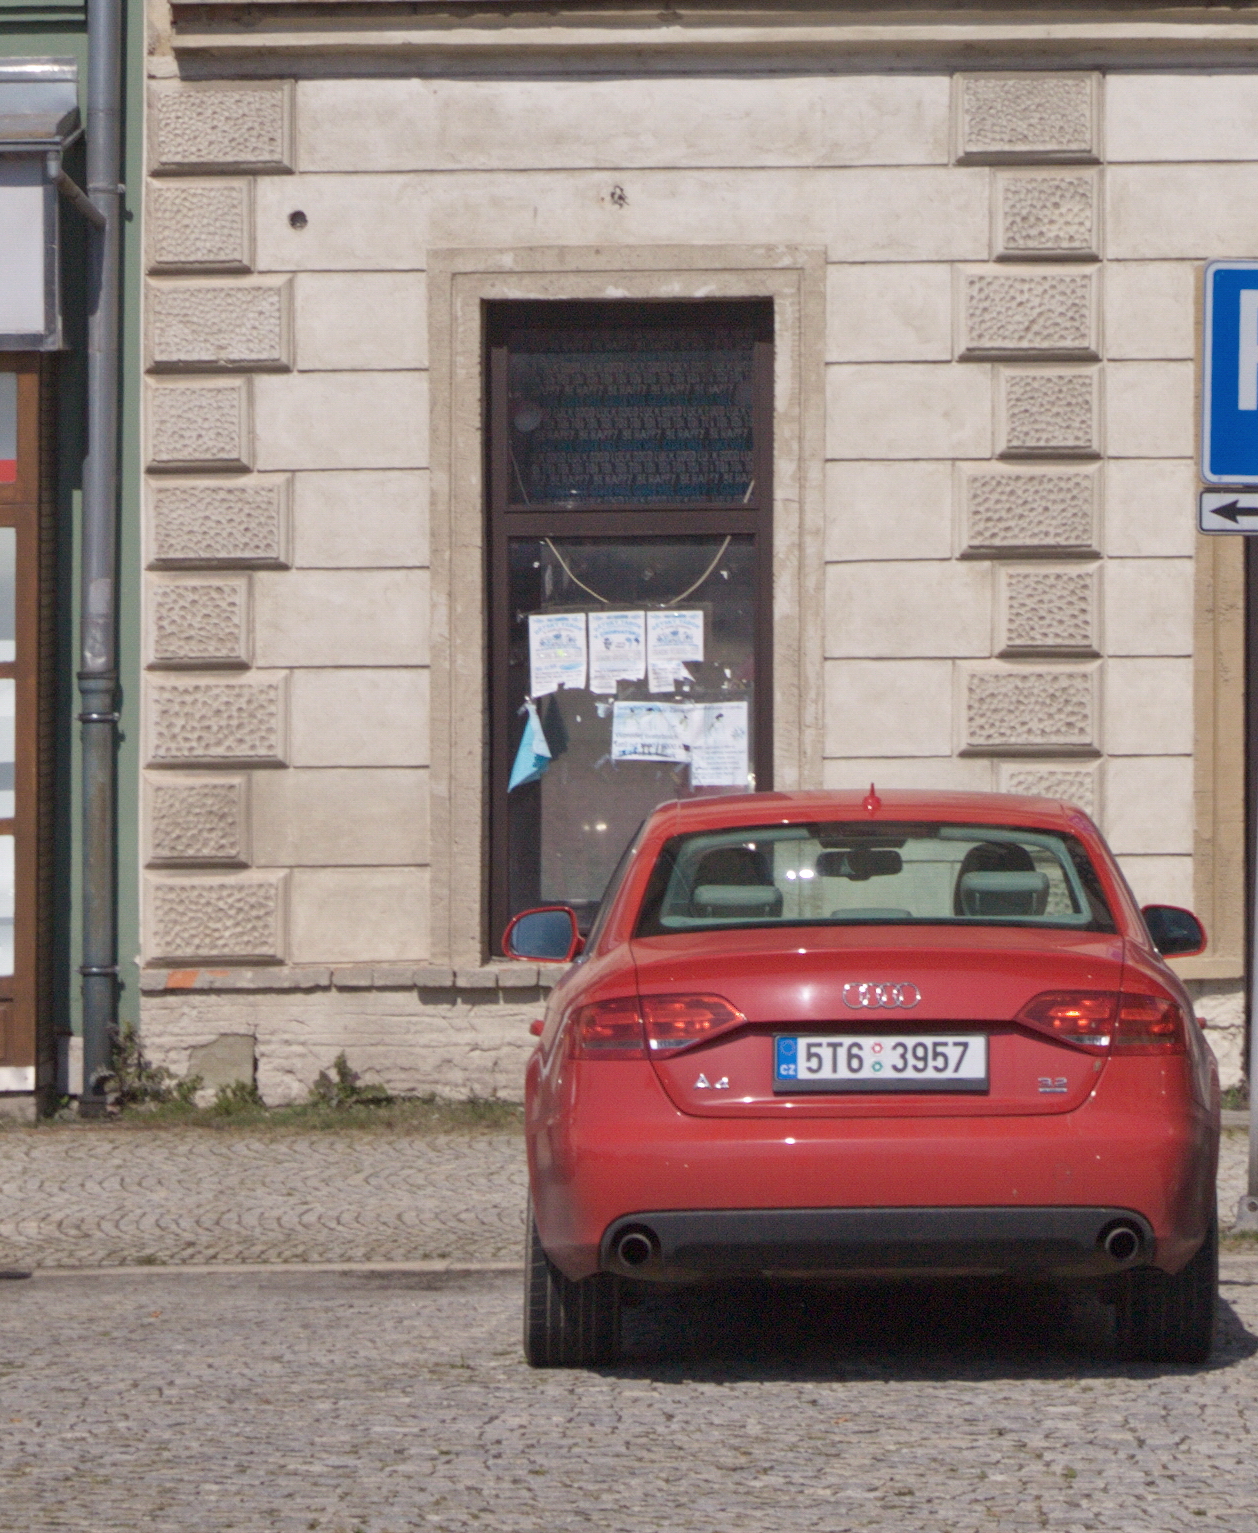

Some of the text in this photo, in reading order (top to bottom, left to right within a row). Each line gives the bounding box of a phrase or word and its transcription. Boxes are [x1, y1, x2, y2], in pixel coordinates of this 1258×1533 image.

[805, 1042, 970, 1075] 5T6 3957
[780, 1065, 796, 1075] CZ
[693, 1073, 730, 1090] A4
